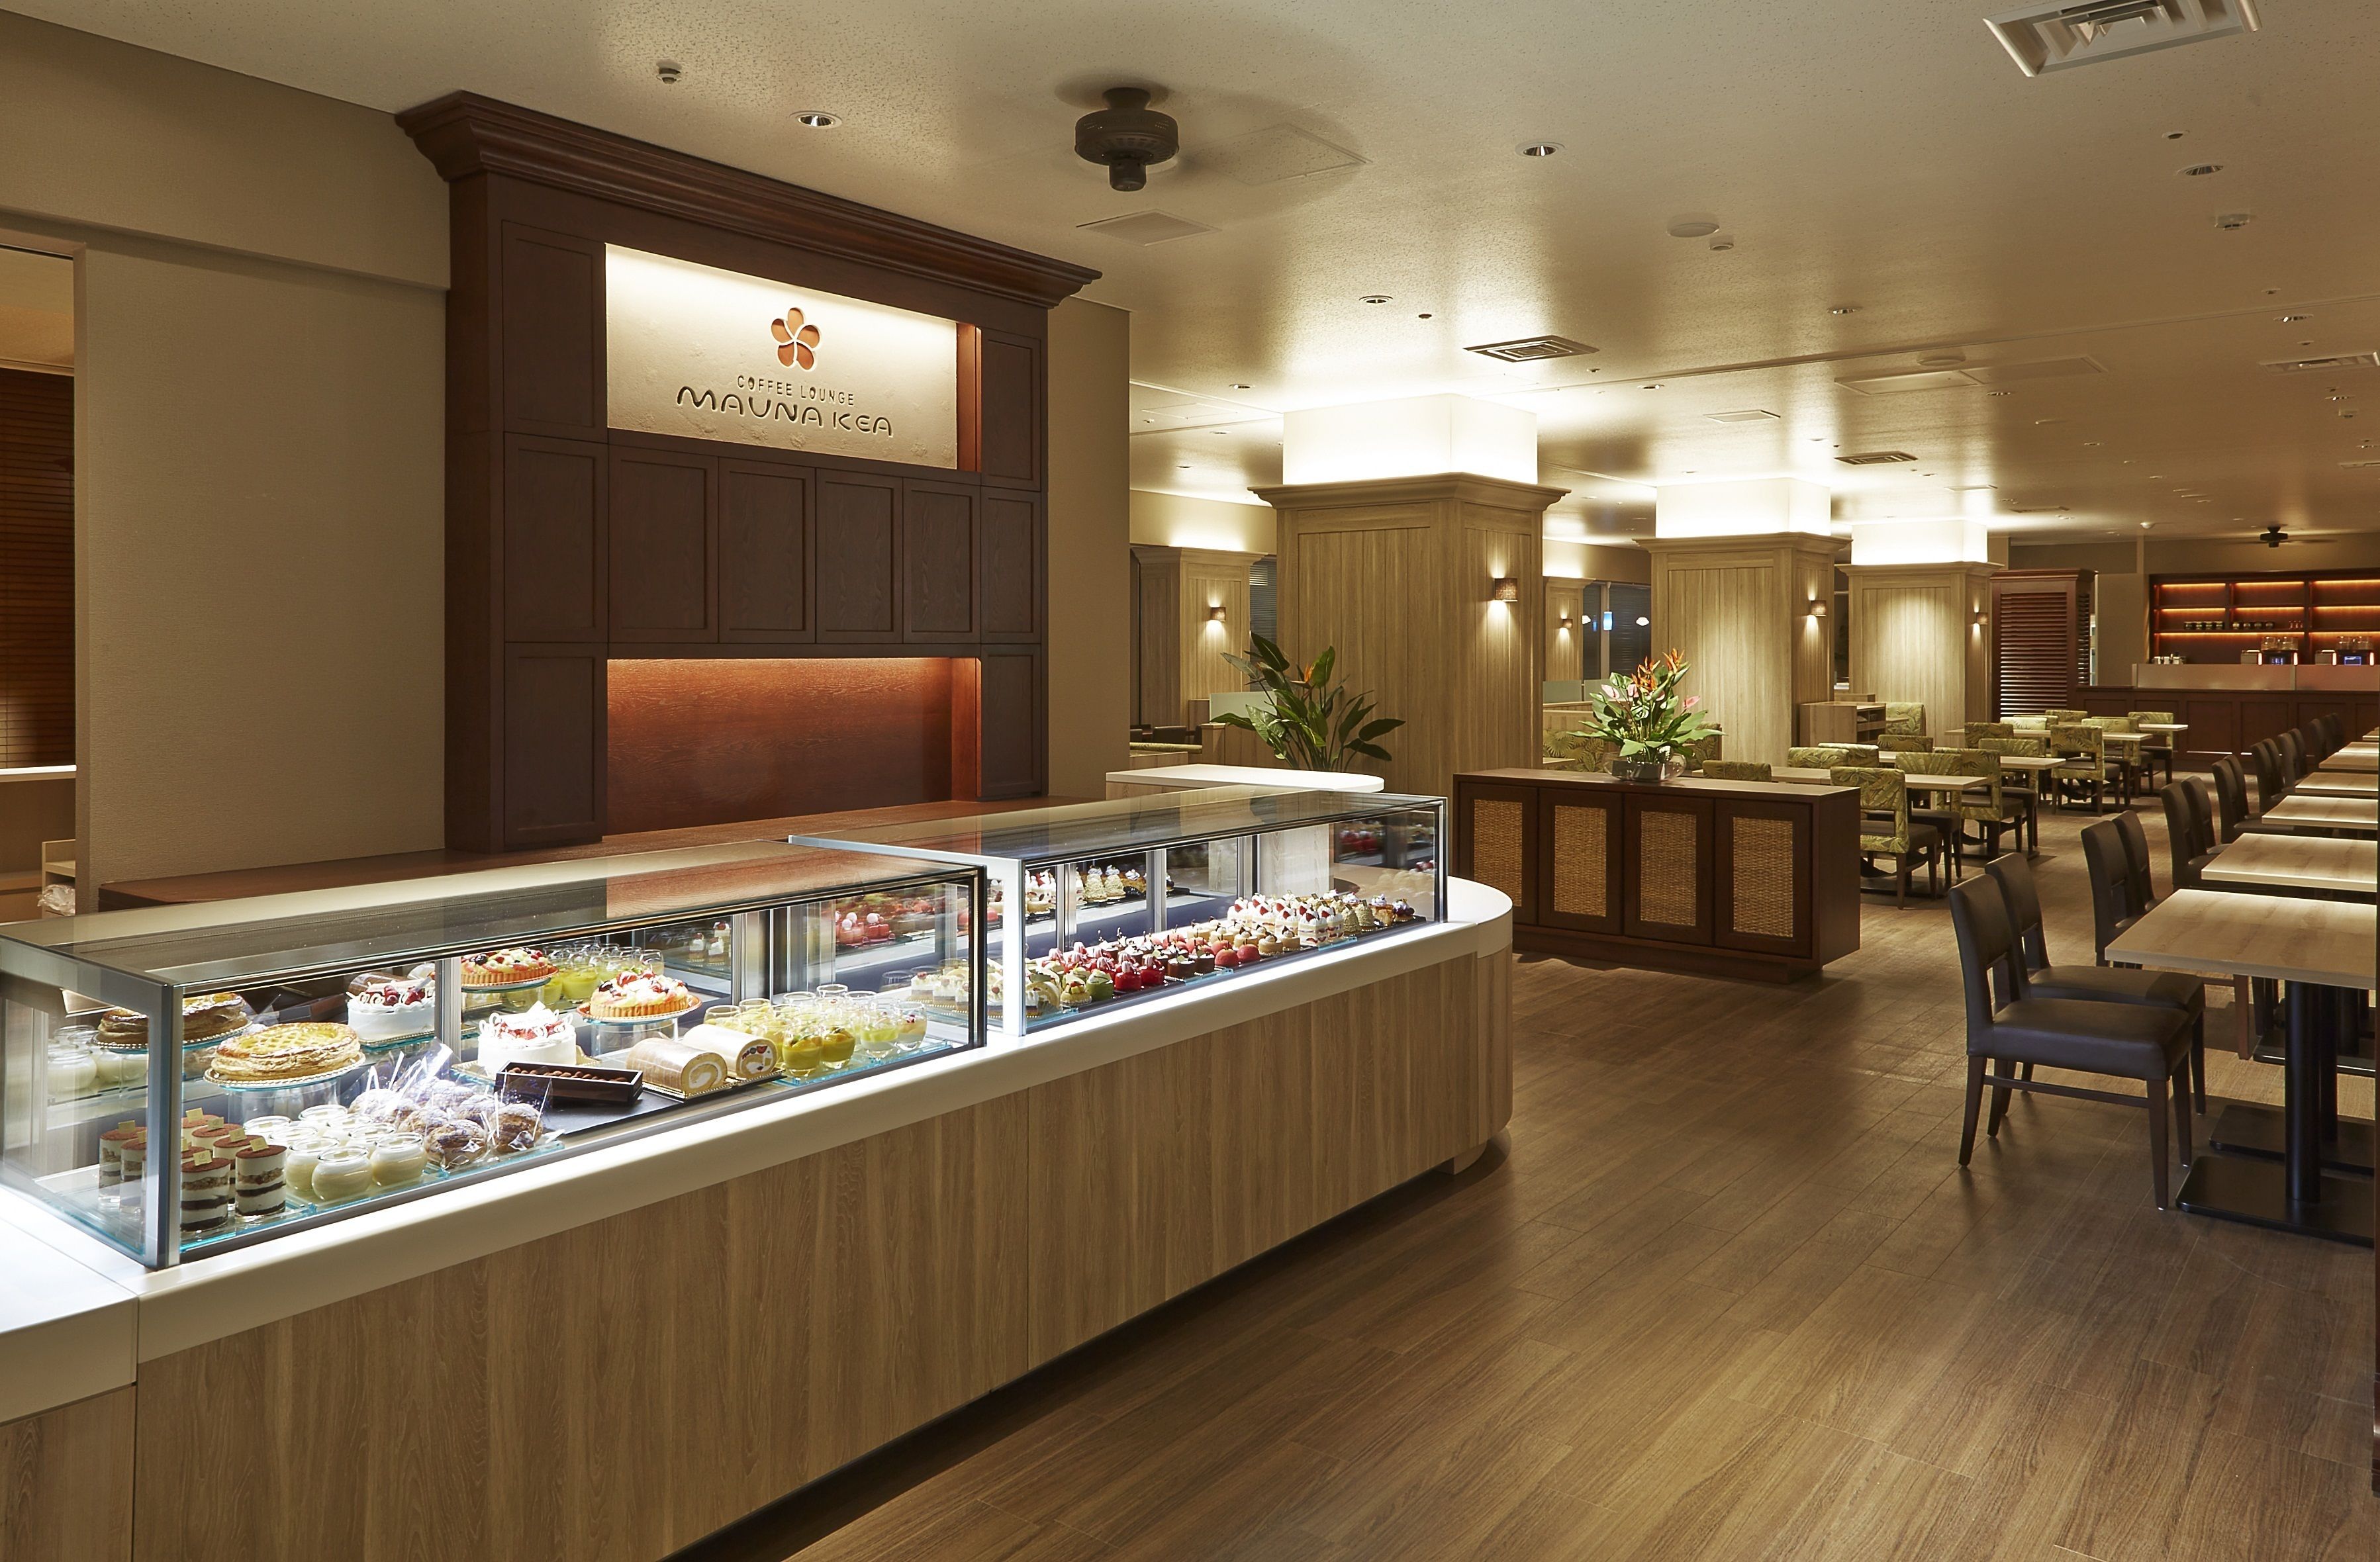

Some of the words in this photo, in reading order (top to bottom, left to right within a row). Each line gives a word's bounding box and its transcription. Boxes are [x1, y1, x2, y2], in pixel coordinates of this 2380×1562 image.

[737, 375, 792, 396] COFFEE
[800, 385, 854, 406] LOUNGE
[677, 386, 823, 427] MAUNA
[833, 411, 893, 437] KEA
